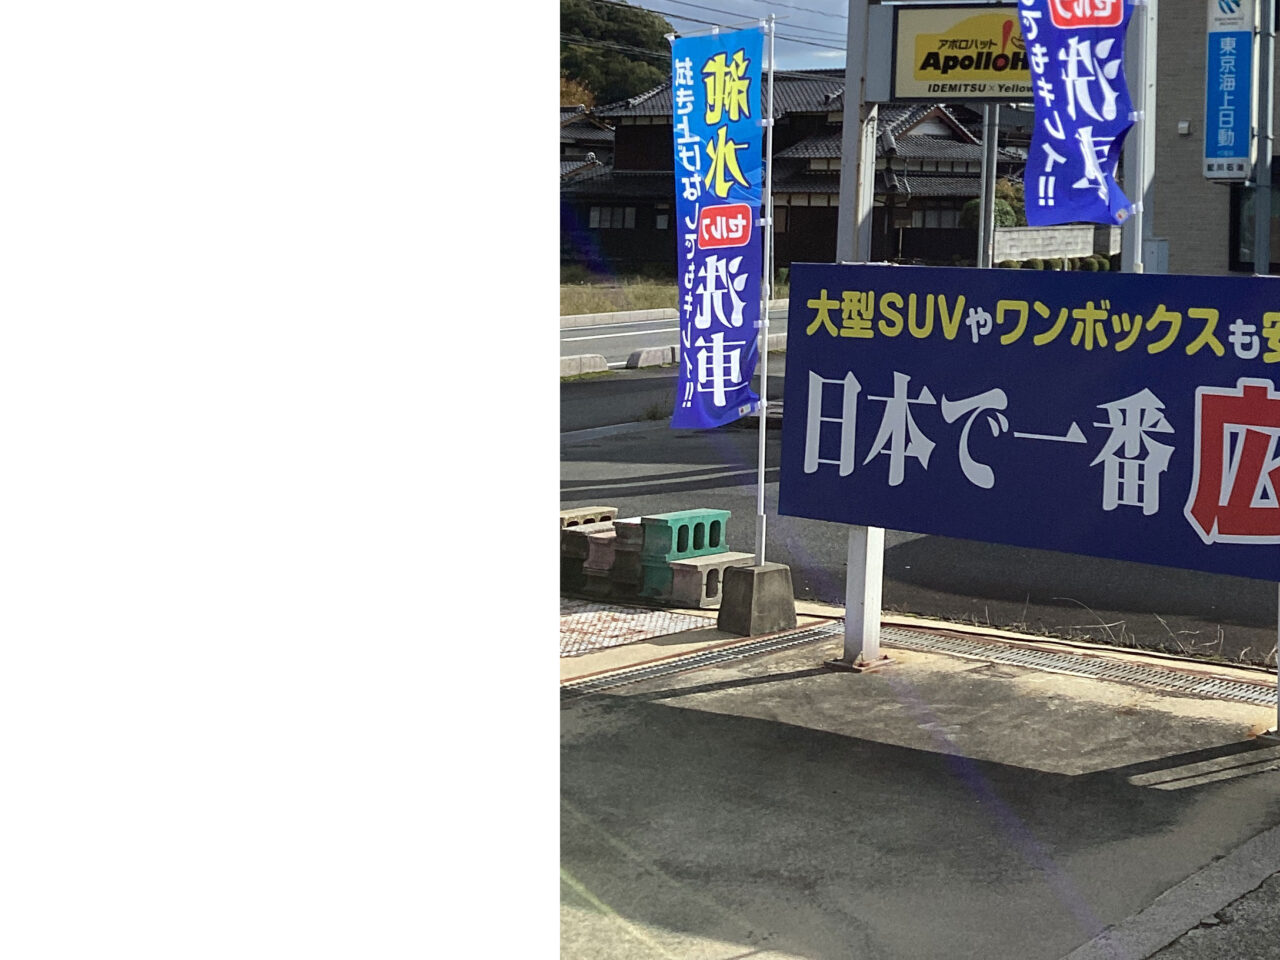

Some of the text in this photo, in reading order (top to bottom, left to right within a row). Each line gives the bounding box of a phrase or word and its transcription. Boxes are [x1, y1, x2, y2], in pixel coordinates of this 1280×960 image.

[937, 38, 997, 50] アポロハット
[928, 83, 986, 93] IDEMITSU
[1217, 37, 1237, 147] 東京海上日動
